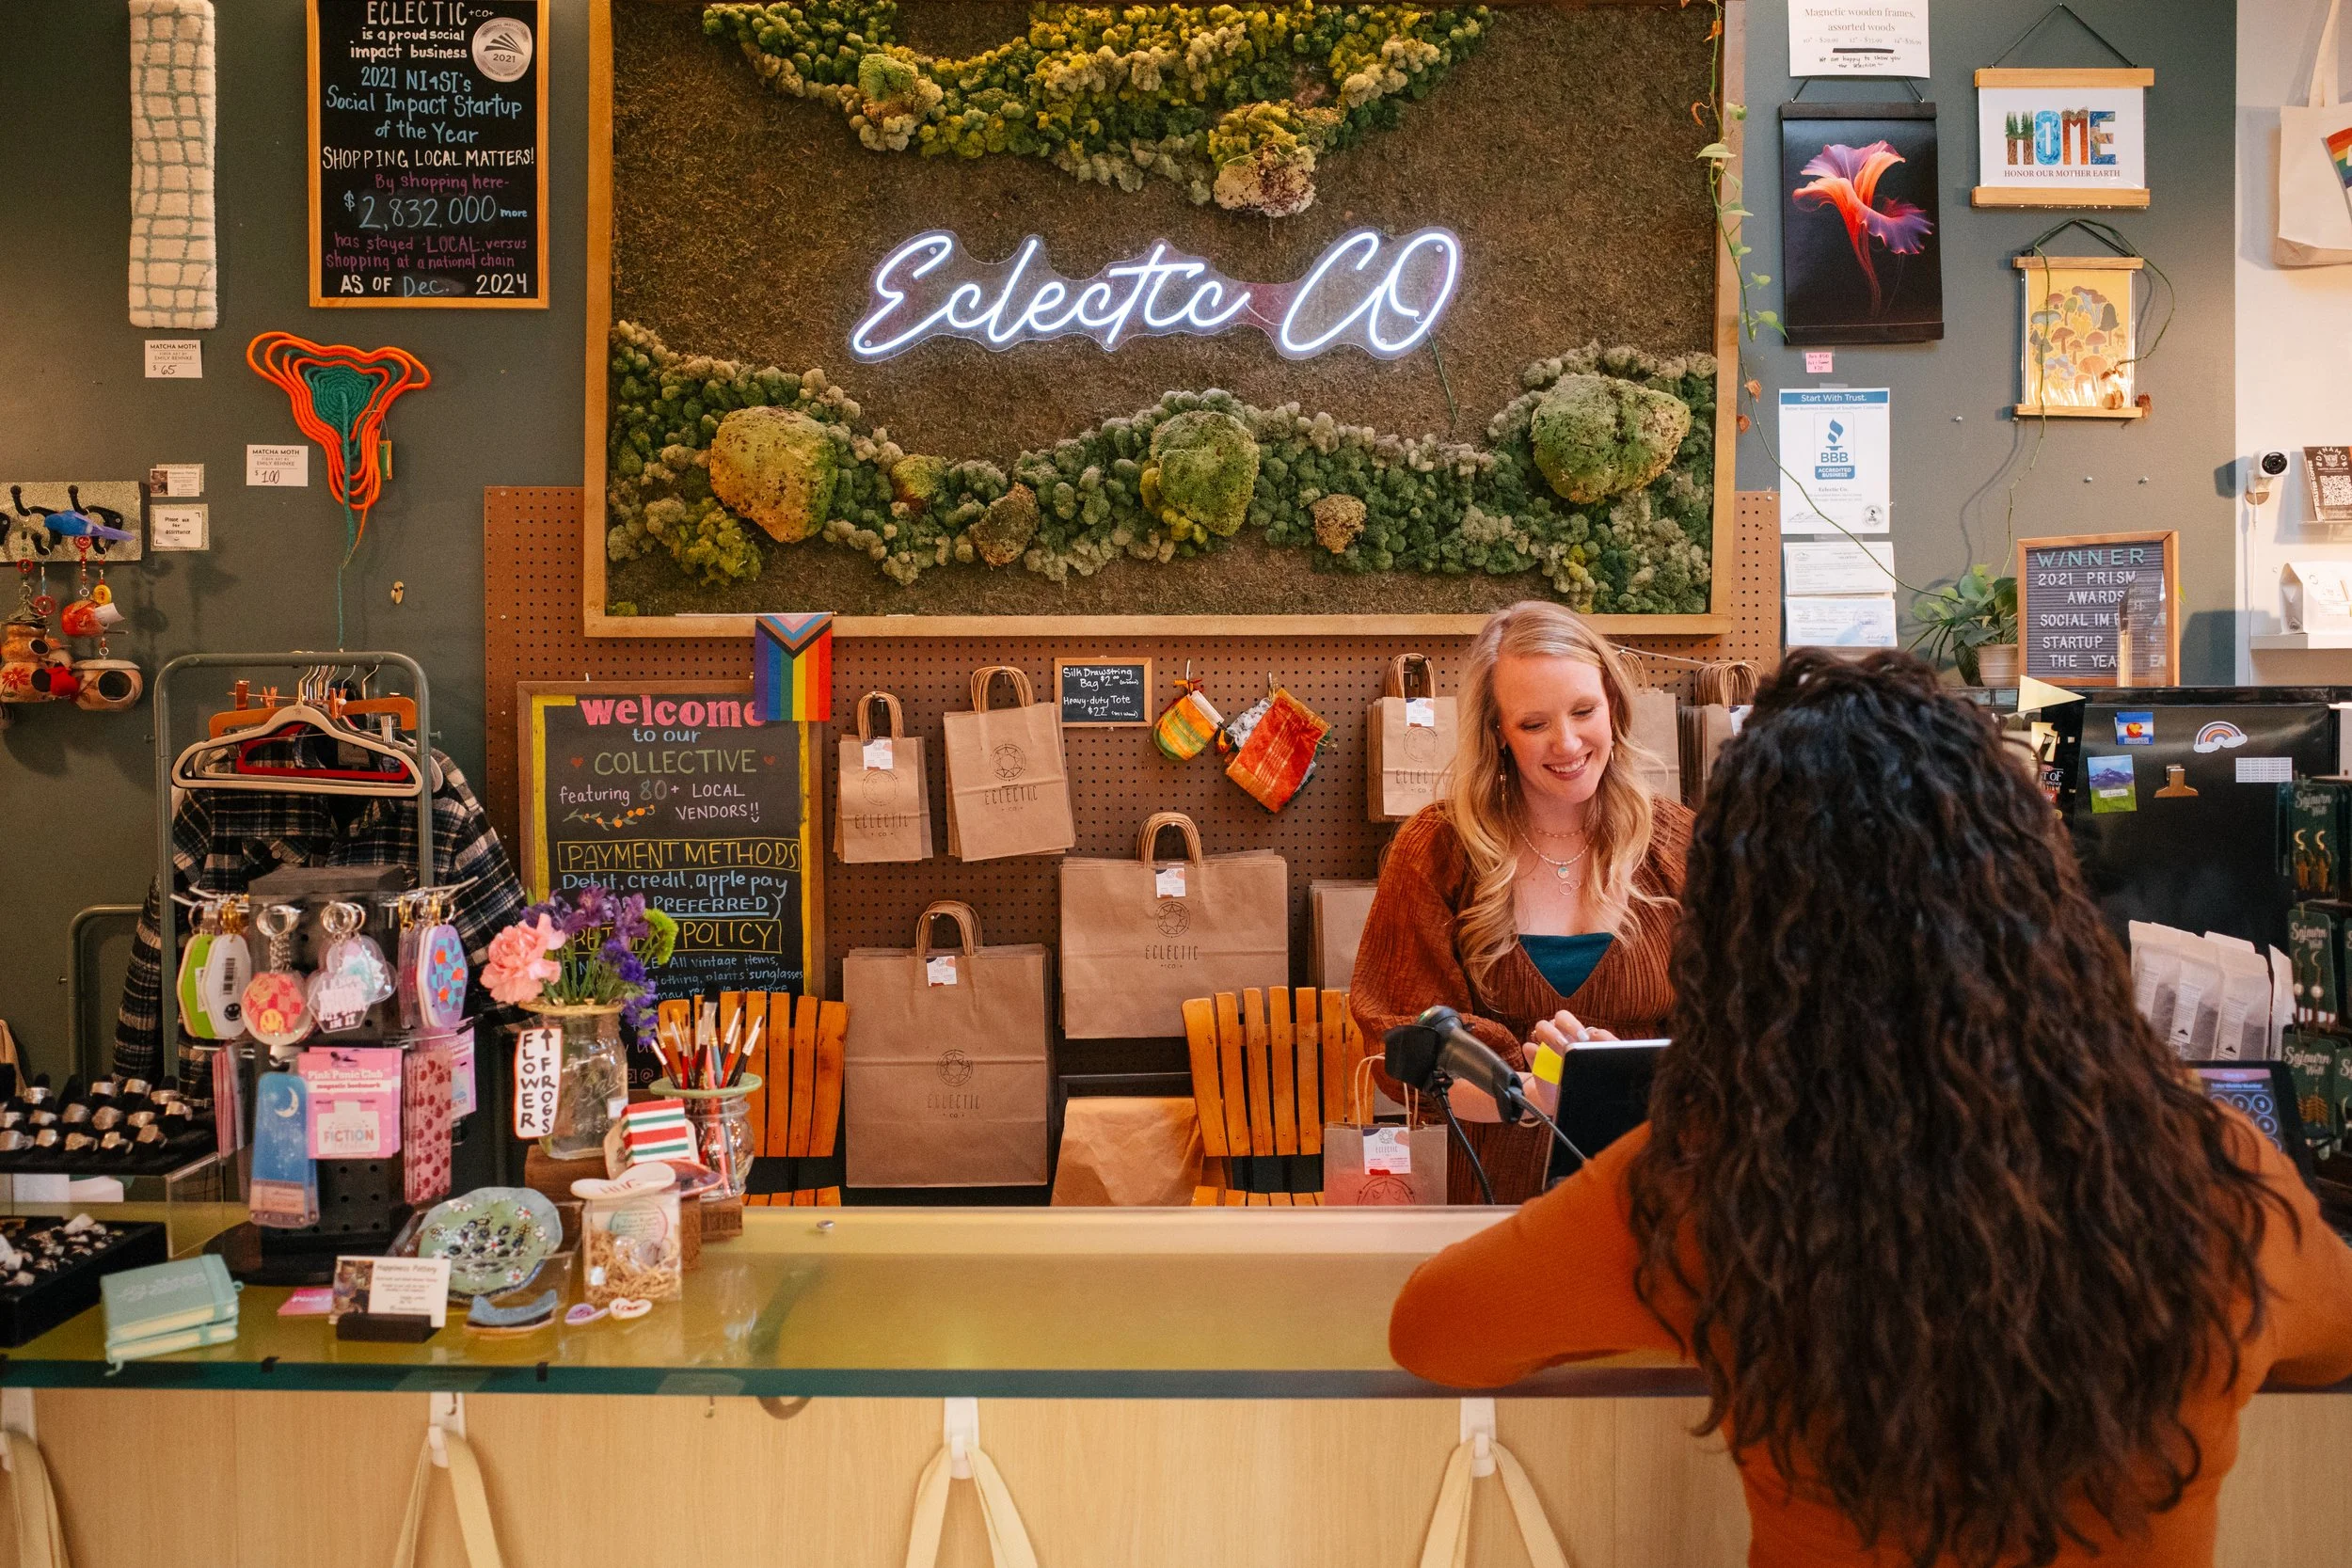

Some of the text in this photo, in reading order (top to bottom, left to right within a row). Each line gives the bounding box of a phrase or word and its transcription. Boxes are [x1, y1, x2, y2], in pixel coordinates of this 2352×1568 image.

[367, 1, 468, 26] ECLECTIC
[1805, 7, 1915, 19] Magnetic wooden frames,
[362, 27, 465, 44] is a proud social
[1828, 23, 1896, 32] assorted woods
[350, 40, 468, 63] impact business
[493, 54, 516, 63] 2021
[361, 66, 397, 88] 2021
[326, 85, 522, 120] Social Impact Startup
[375, 120, 479, 144] of the Year
[2005, 107, 2116, 166] HOME
[322, 146, 534, 169] SHOPPING LOCAL MATTERS!
[375, 171, 509, 196] By shopping here-
[500, 208, 528, 218] more
[334, 232, 527, 255] has stayed versus
[326, 249, 515, 272] shopping at a national chain
[340, 274, 528, 298] AS OF Dec. 2024
[853, 233, 1251, 355] Eclectic
[1845, 393, 1867, 402] Trust.
[1820, 452, 1849, 463] BBB
[2315, 446, 2347, 462] DYNAMO
[2037, 548, 2144, 567] WINNER
[2038, 571, 2137, 586] 2021 PRISM
[2067, 591, 2124, 605] AWARDS
[2040, 613, 2089, 627] SOCIAL
[2042, 636, 2104, 649] STARTUP
[2049, 655, 2118, 668] THE YEA
[1062, 667, 1133, 681] Silk Drawstring
[1080, 678, 1099, 691] Bag
[1063, 695, 1131, 708] Heavy-duty Tote
[1088, 705, 1107, 716] $22
[632, 728, 701, 743] to our
[594, 750, 756, 775] COLLECTIVE
[560, 784, 630, 807] featuring
[692, 784, 745, 798] LOCAL
[984, 786, 1038, 805] ECLECTIC
[675, 802, 759, 820] VENDORS!!
[854, 813, 909, 829] ECLECTIC
[568, 841, 800, 870] PAYMENT METHODS
[696, 870, 746, 896] apple
[751, 876, 788, 898] pay
[683, 922, 773, 951] POLICY
[1145, 945, 1199, 959] ECLECTIC
[670, 956, 687, 969] All
[691, 956, 737, 970] vintage
[745, 954, 779, 967] items,
[309, 1069, 383, 1079] Pink Panic Club
[520, 1033, 539, 1129] FLOWER
[541, 1057, 556, 1133] FROGS
[928, 1094, 980, 1110] ECLECTIC
[324, 1130, 374, 1143] FICTION
